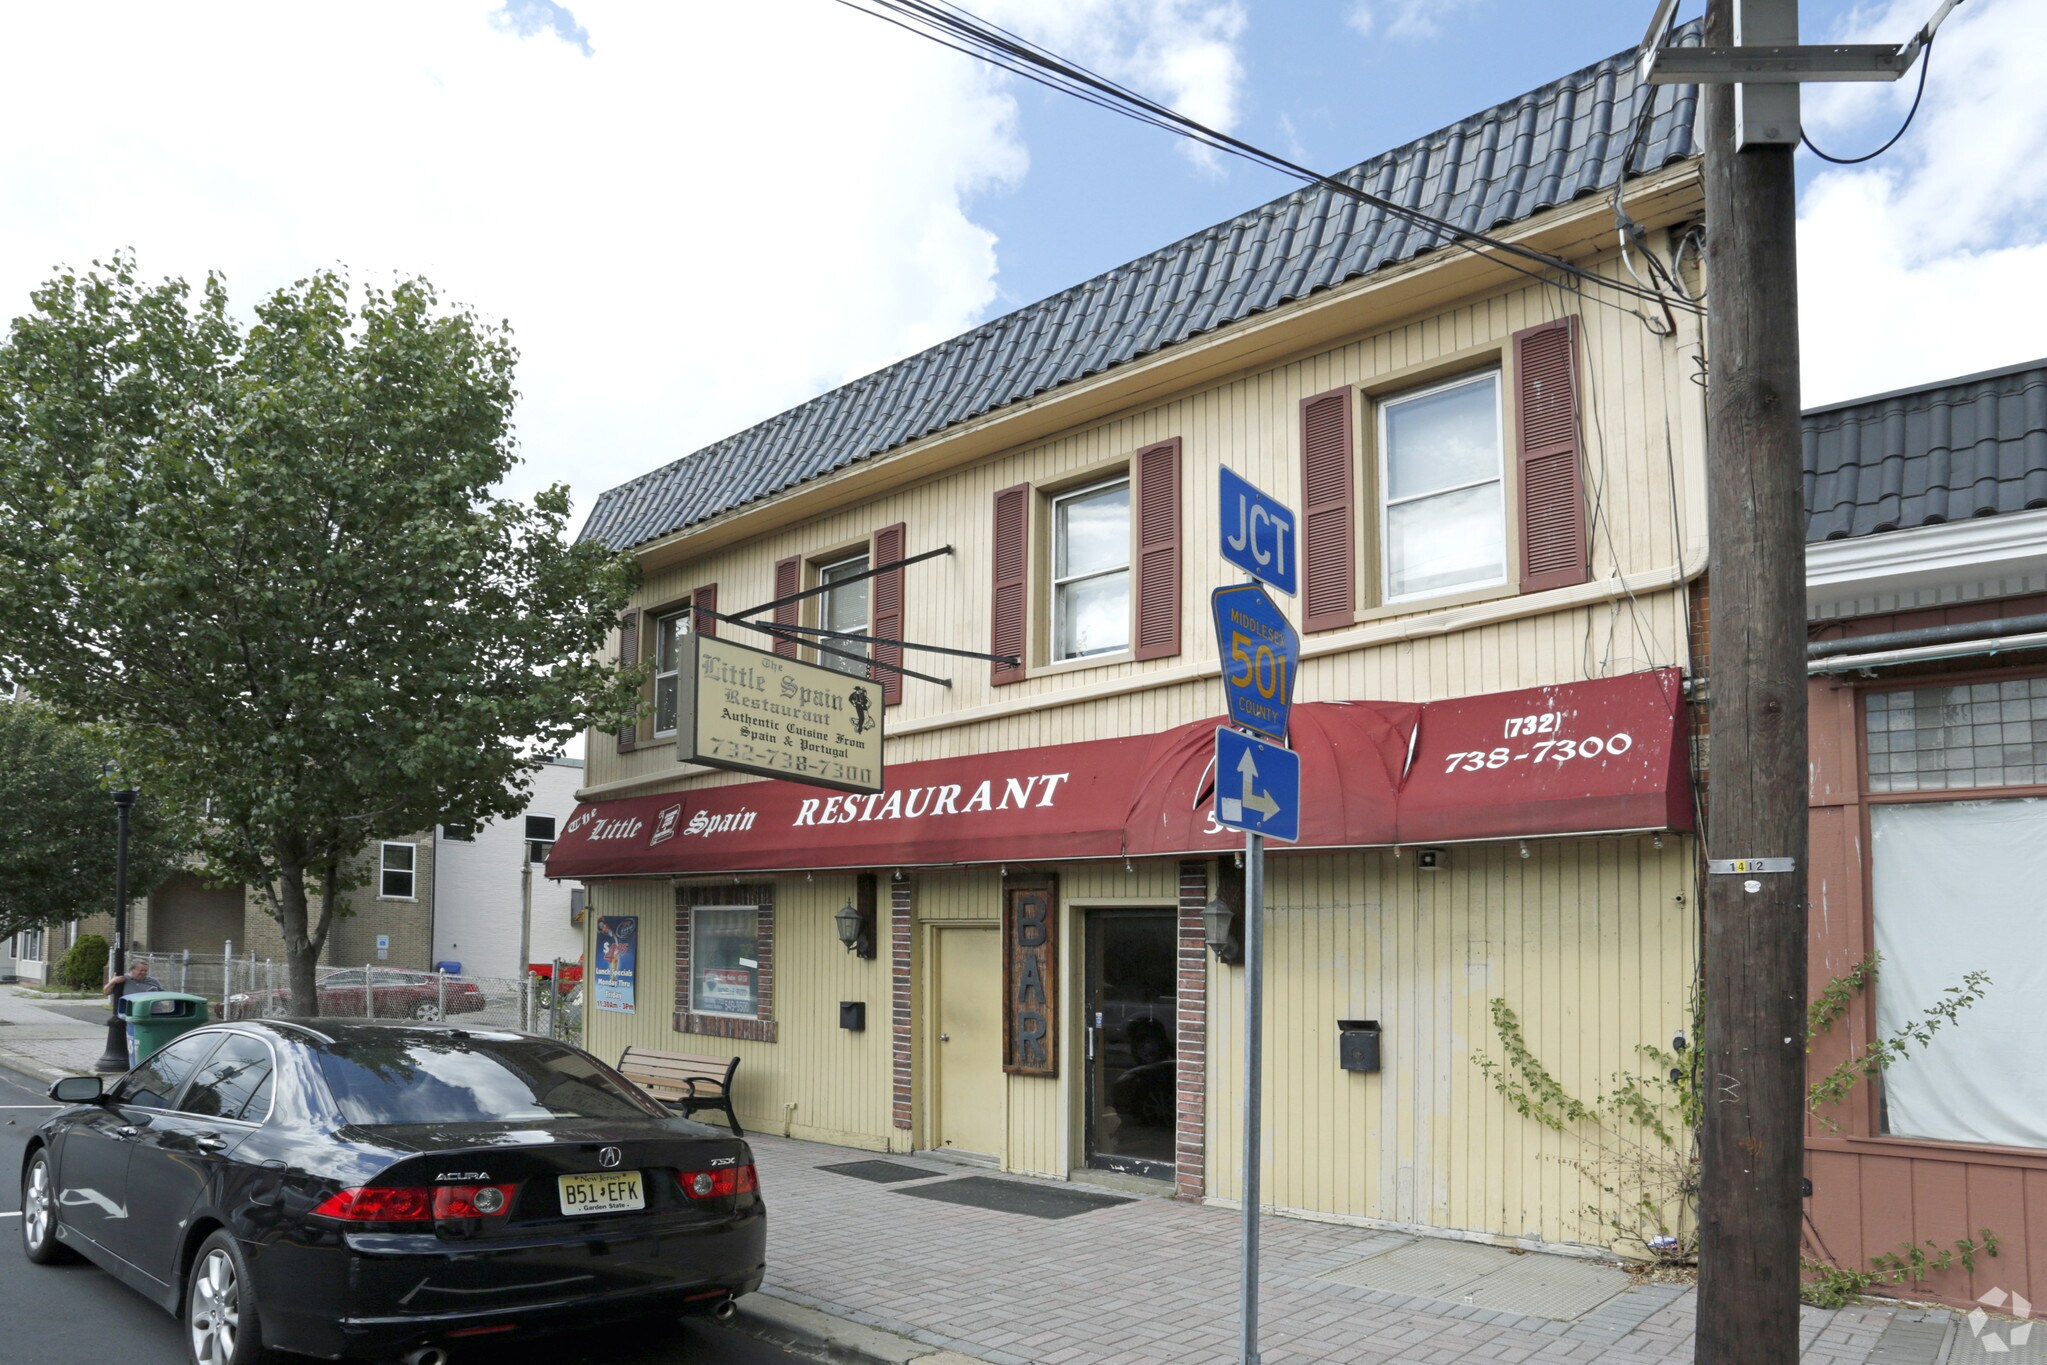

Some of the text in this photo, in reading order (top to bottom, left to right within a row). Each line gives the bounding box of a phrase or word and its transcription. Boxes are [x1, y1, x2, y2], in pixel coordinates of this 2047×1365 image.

[1227, 493, 1289, 576] JCT
[1231, 607, 1286, 647] MIDDLESEX
[761, 657, 784, 672] The
[1231, 630, 1287, 706] 501
[702, 653, 844, 711] Little Spain
[724, 687, 831, 726] Restaurant
[1238, 696, 1279, 725] COUNTY
[720, 707, 866, 750] Authentic Cuisine From
[739, 725, 849, 759] Spain & Portugal
[1503, 711, 1562, 740] (732)
[710, 736, 873, 784] 732-738-7300
[1444, 732, 1633, 774] 738-7300
[567, 773, 1070, 842] The Little Spain RESTAURANT
[1729, 861, 1764, 872] 1412
[595, 967, 633, 977] Lunch Specials
[597, 978, 618, 988] Monday
[1017, 894, 1047, 1065] BAR
[434, 1171, 491, 1181] ACURA
[580, 1173, 621, 1183] New Jersey
[711, 1157, 736, 1166] TSX
[583, 1202, 626, 1212] Garden State
